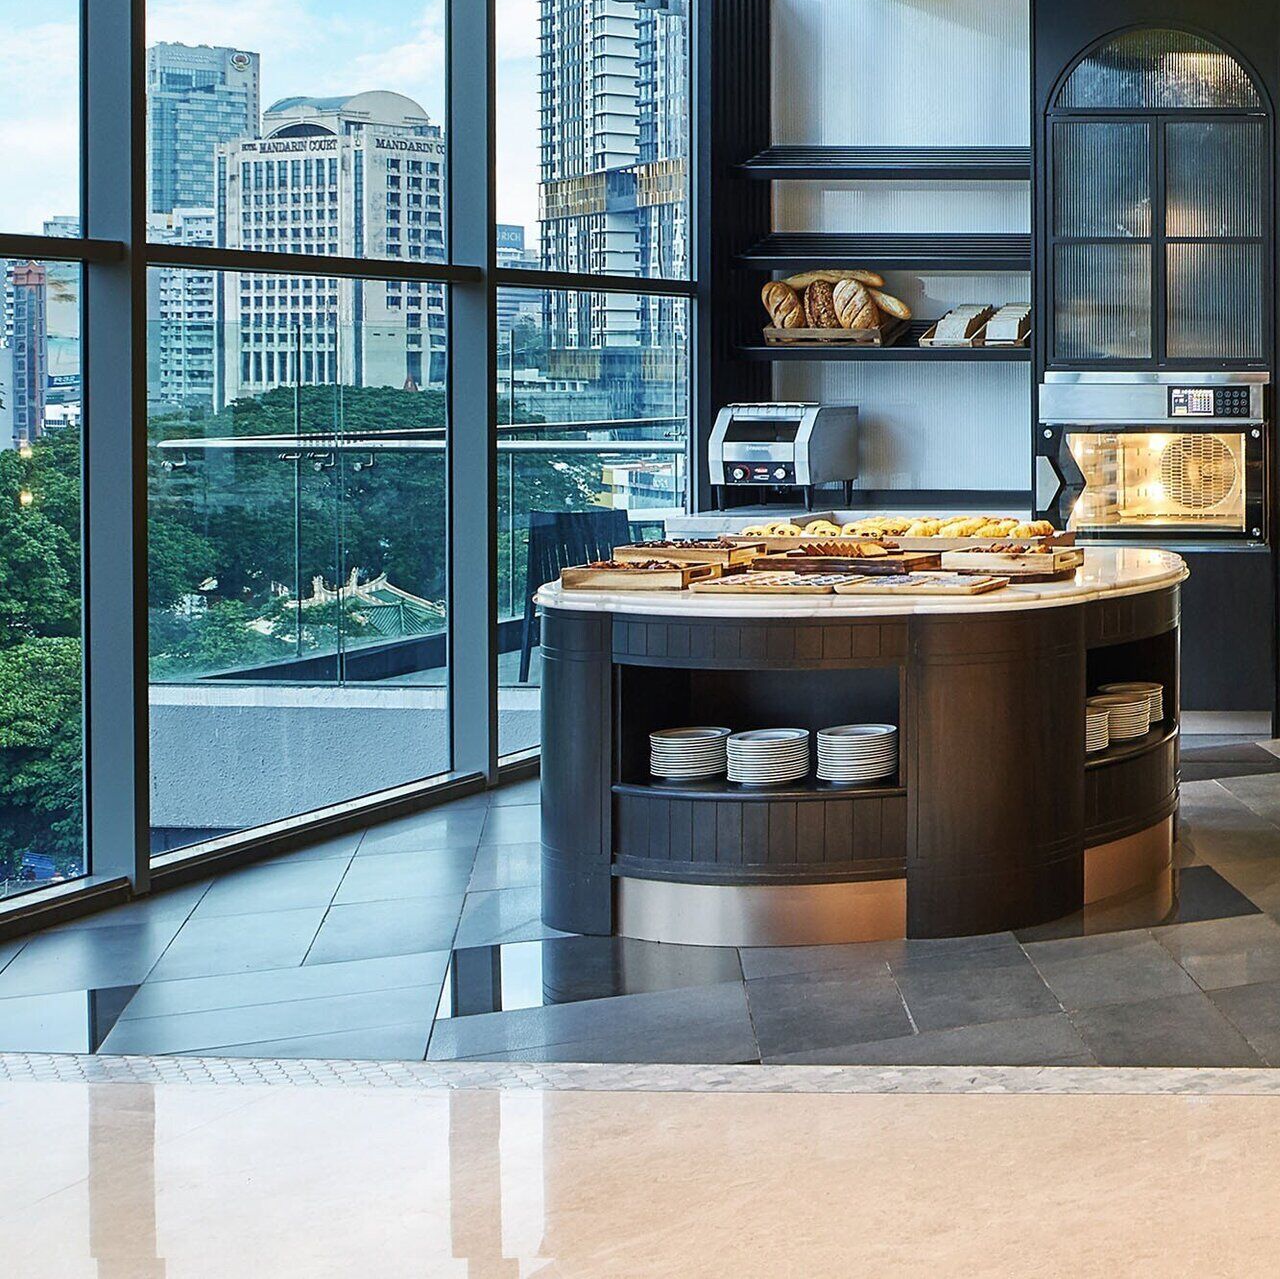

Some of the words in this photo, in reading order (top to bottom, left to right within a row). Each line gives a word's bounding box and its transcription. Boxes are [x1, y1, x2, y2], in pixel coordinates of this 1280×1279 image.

[259, 140, 307, 153] MANDARIN
[309, 139, 338, 151] COURT
[375, 138, 433, 153] MANDARIN
